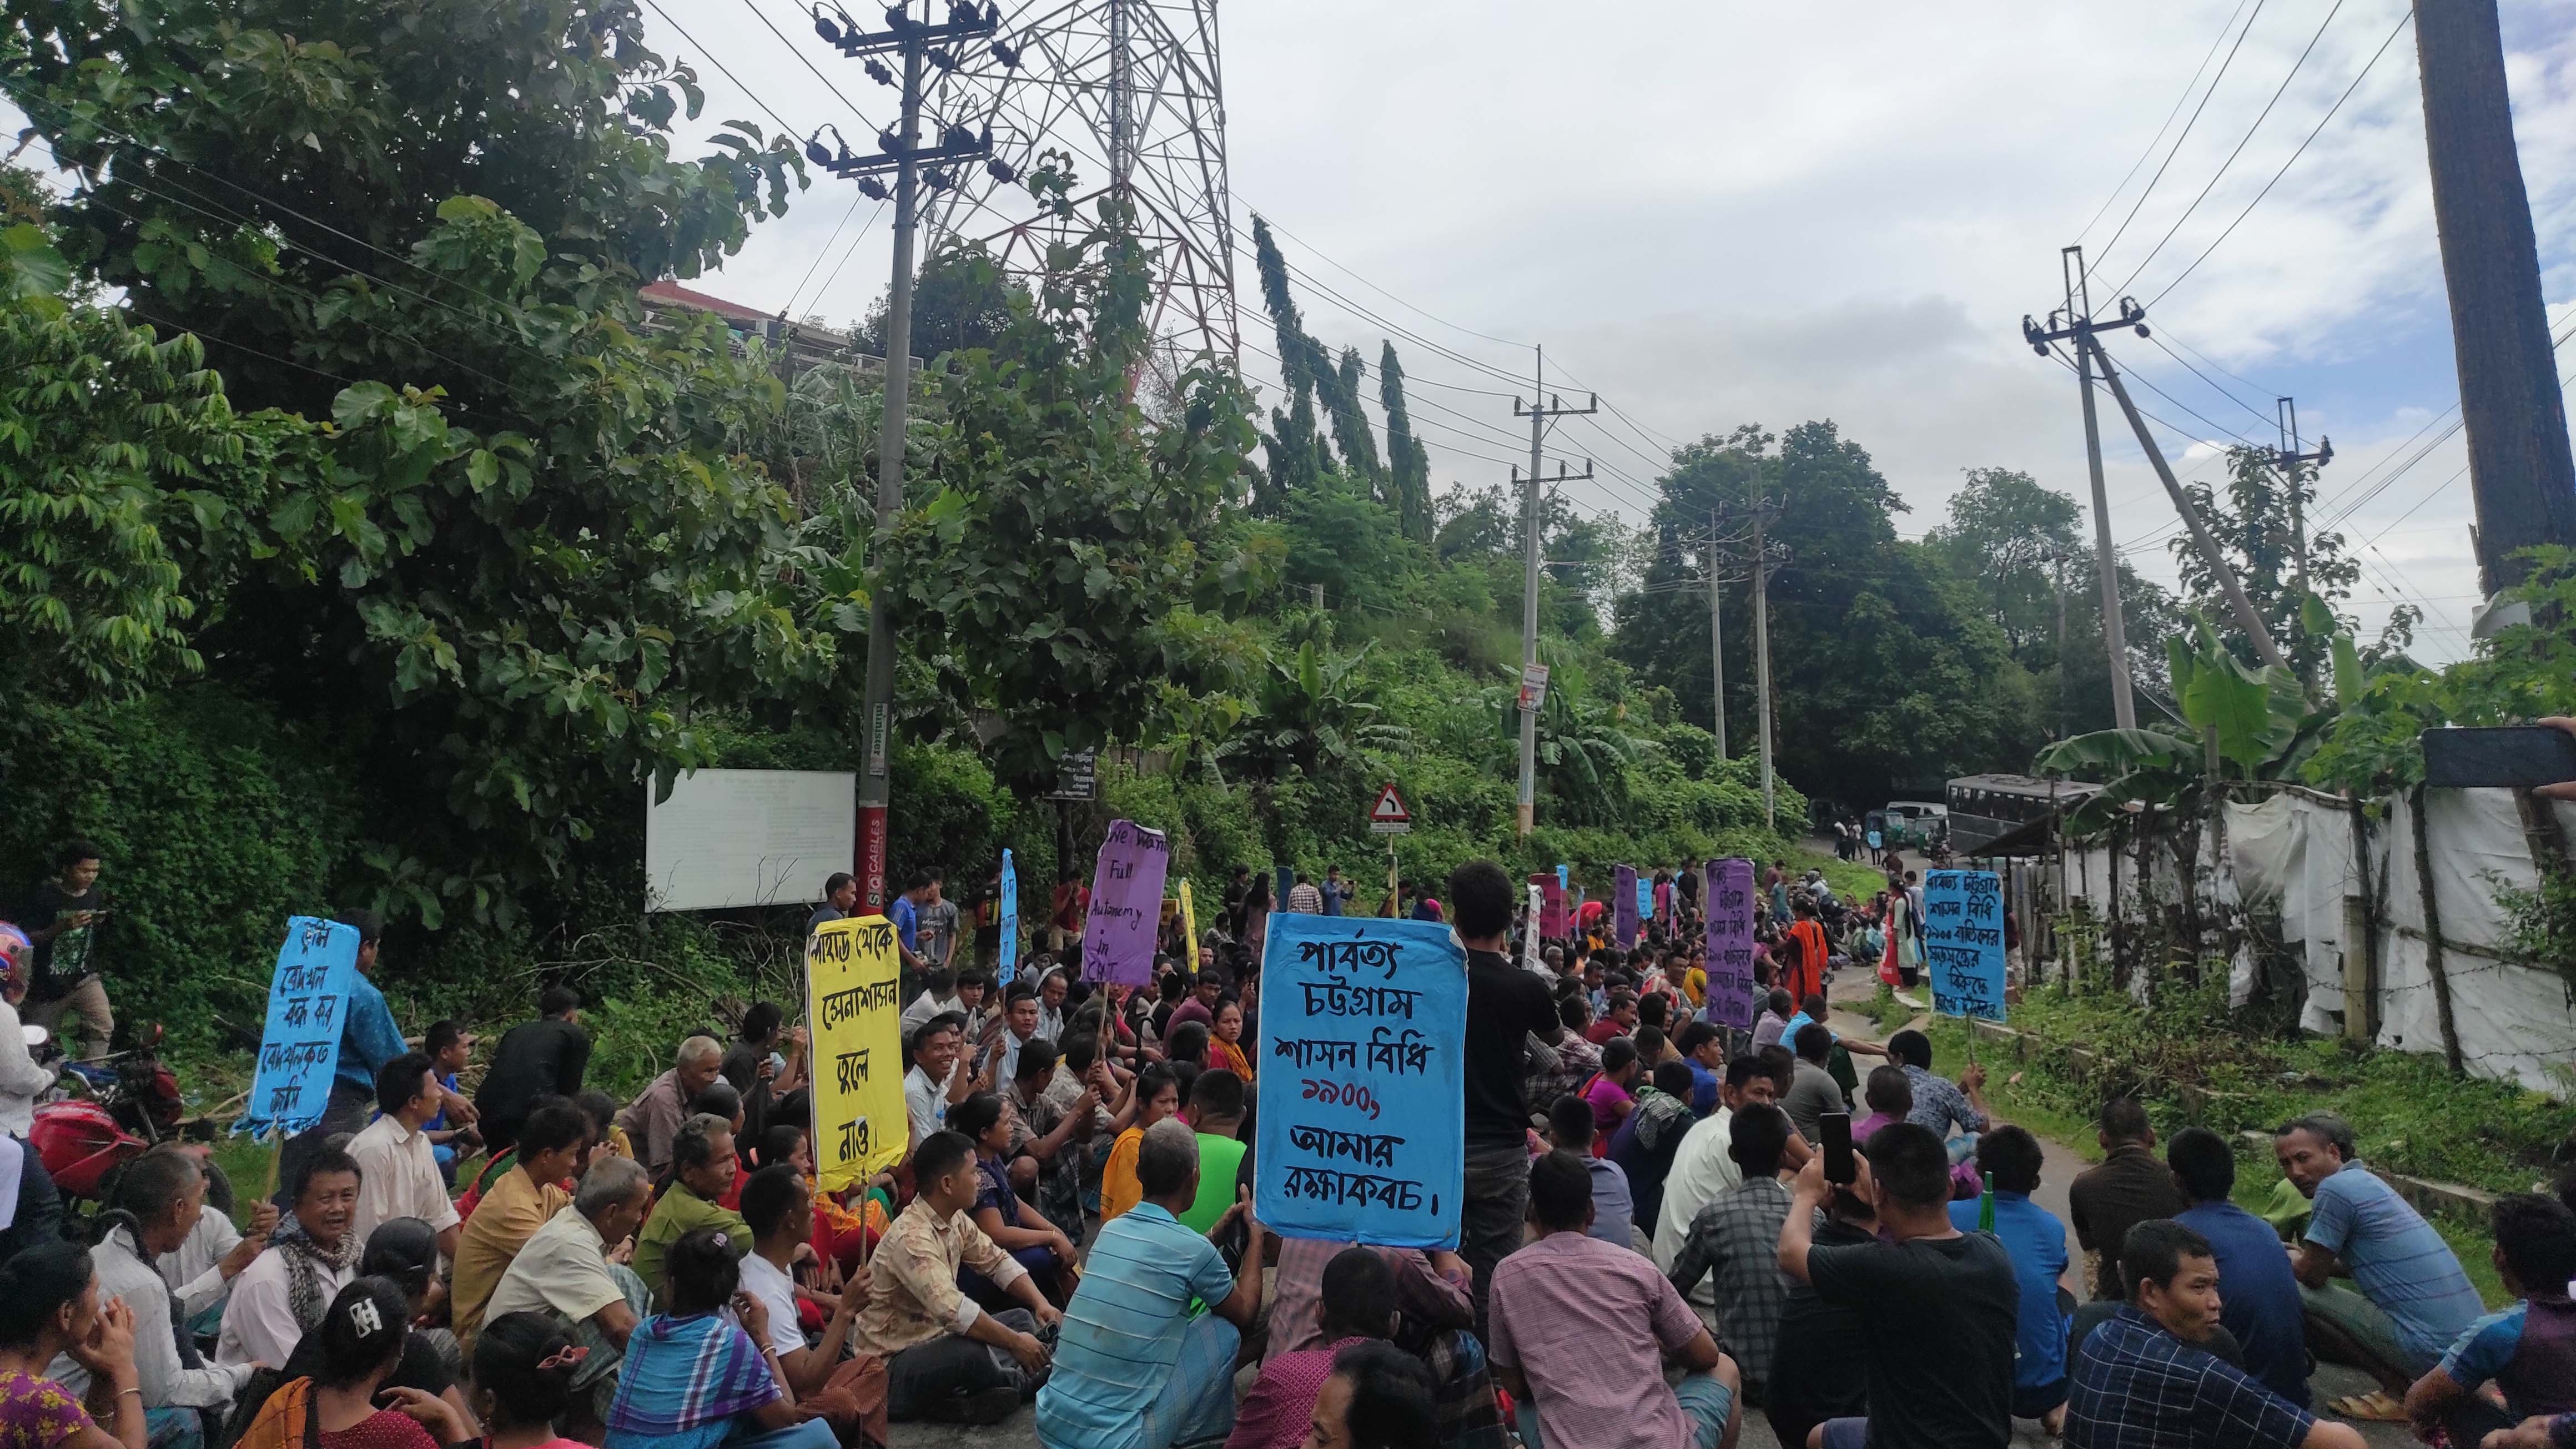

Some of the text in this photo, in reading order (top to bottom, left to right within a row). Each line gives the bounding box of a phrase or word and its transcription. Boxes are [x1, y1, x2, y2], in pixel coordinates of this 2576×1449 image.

[868, 819, 880, 872] CABLES
[1136, 831, 1166, 852] Wan
[1110, 861, 1133, 880] Full
[1091, 898, 1143, 931] Autonomy
[1967, 894, 1997, 920] বিধি
[856, 923, 893, 961] থেকে
[1296, 928, 1403, 980] পার্বত্য
[822, 978, 898, 1031] সেনাশাসন
[1297, 975, 1423, 1020] চট্টগ্রাম
[836, 1048, 869, 1095] তুলে
[1274, 1026, 1435, 1076] শাসন বিধি
[1289, 1124, 1406, 1169] আমার
